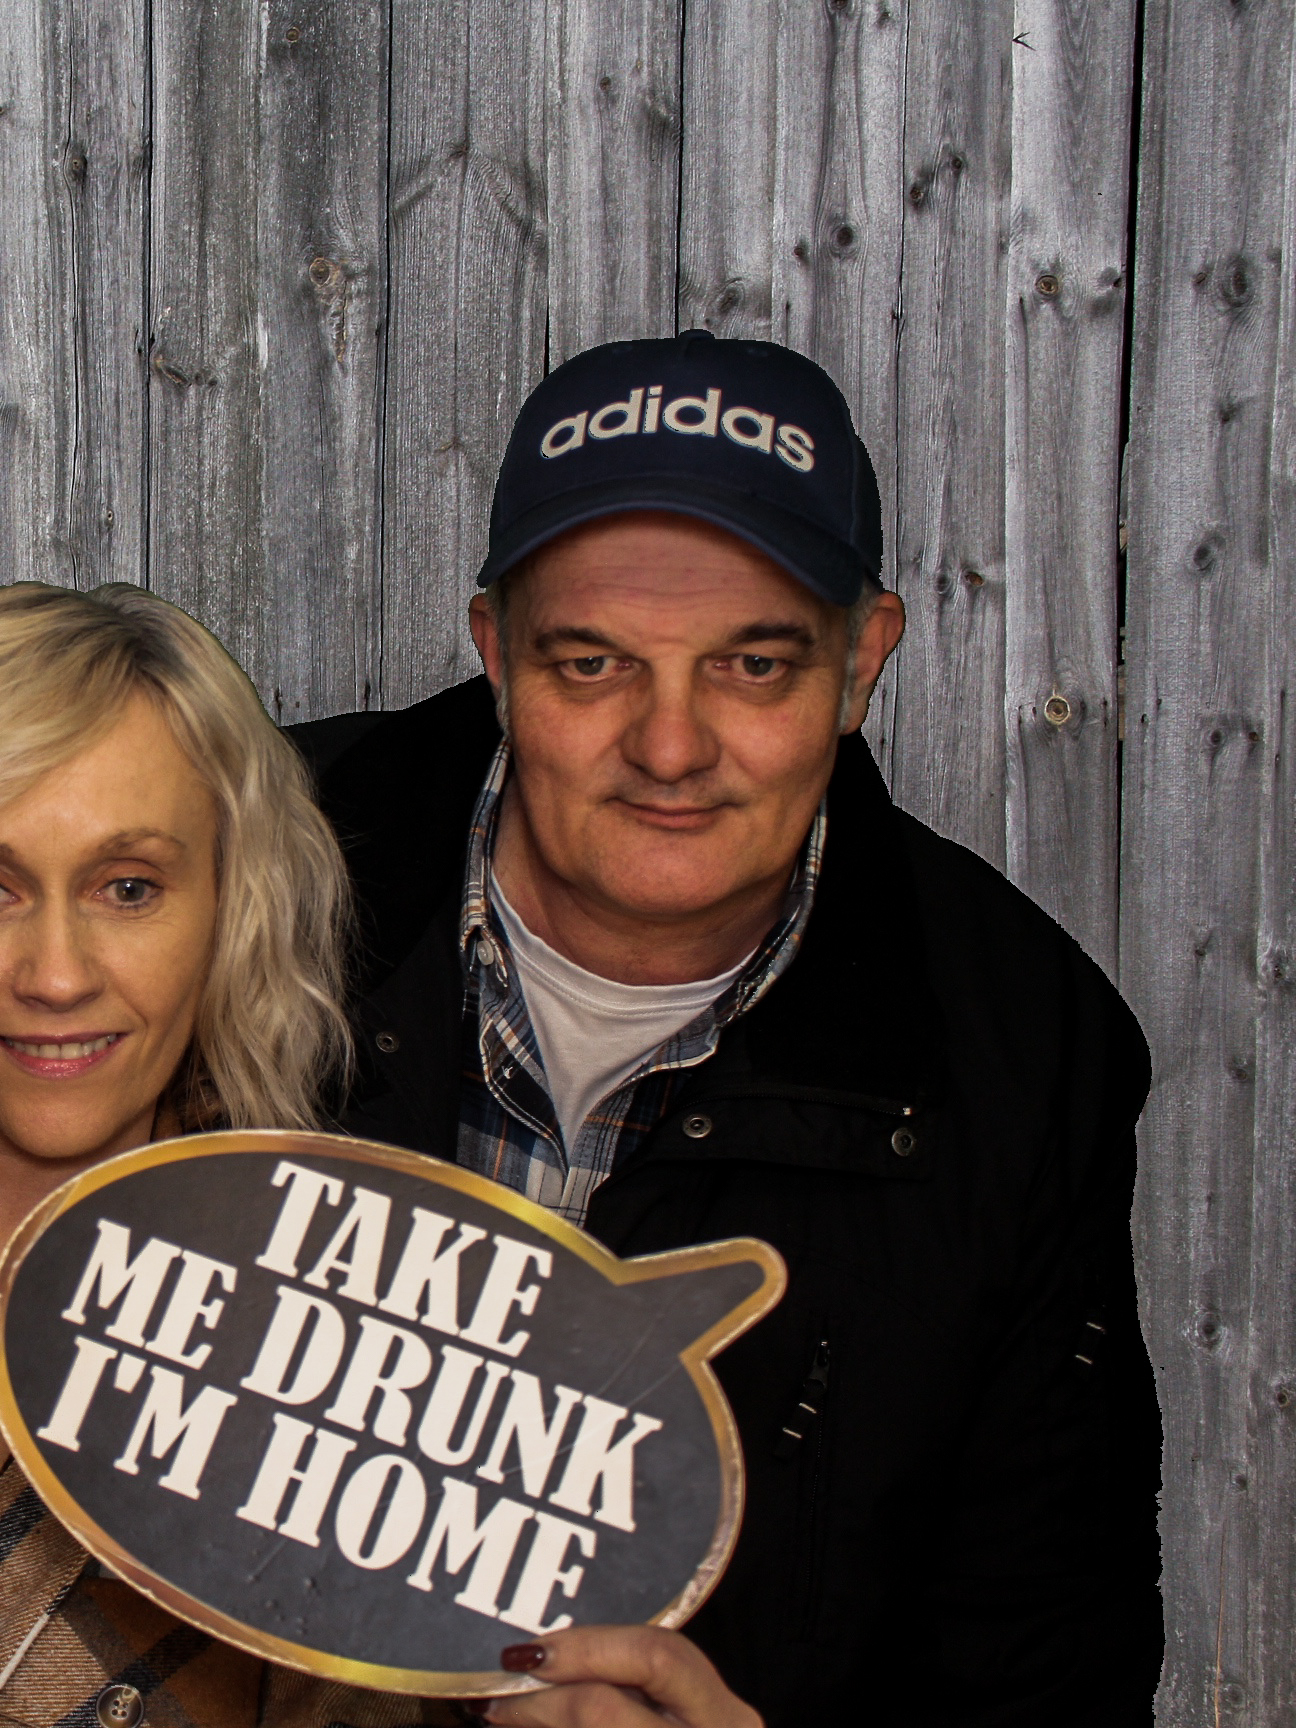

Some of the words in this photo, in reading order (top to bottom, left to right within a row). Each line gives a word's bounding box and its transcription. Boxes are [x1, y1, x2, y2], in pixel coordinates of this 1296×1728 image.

[540, 385, 814, 472] adidas
[62, 1219, 237, 1371] ME
[241, 1286, 663, 1532] DRUNK
[255, 1161, 553, 1358] TAKE
[36, 1336, 238, 1500] I'M
[236, 1412, 597, 1636] HOME
